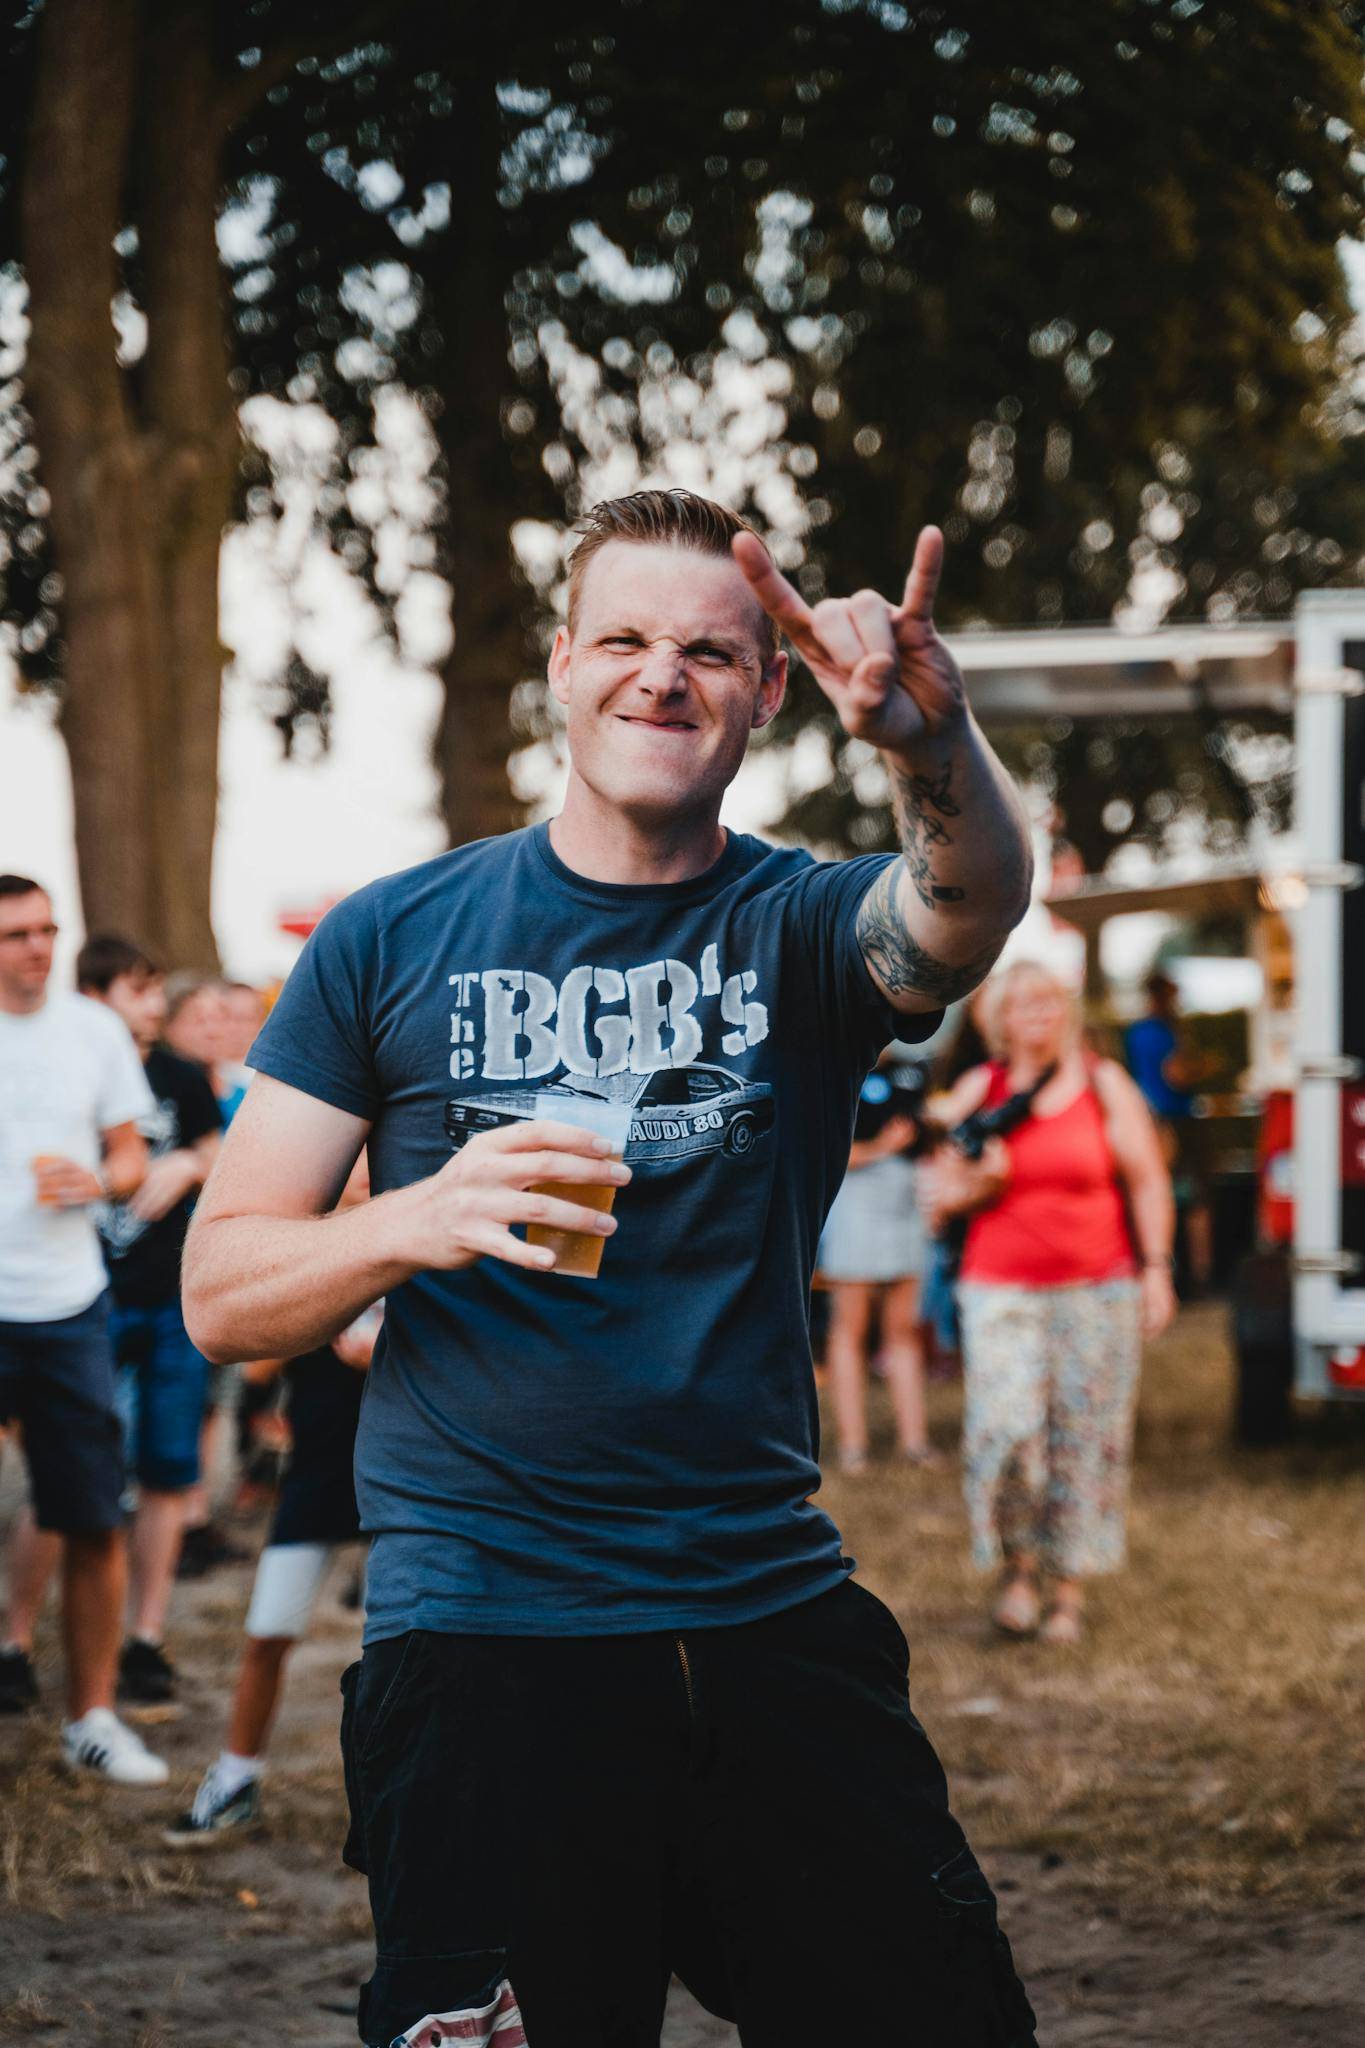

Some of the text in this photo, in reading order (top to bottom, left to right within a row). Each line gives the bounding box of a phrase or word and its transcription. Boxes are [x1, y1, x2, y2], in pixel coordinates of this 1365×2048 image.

[448, 972, 479, 1080] The
[628, 1110, 724, 1142] AUDI 80
